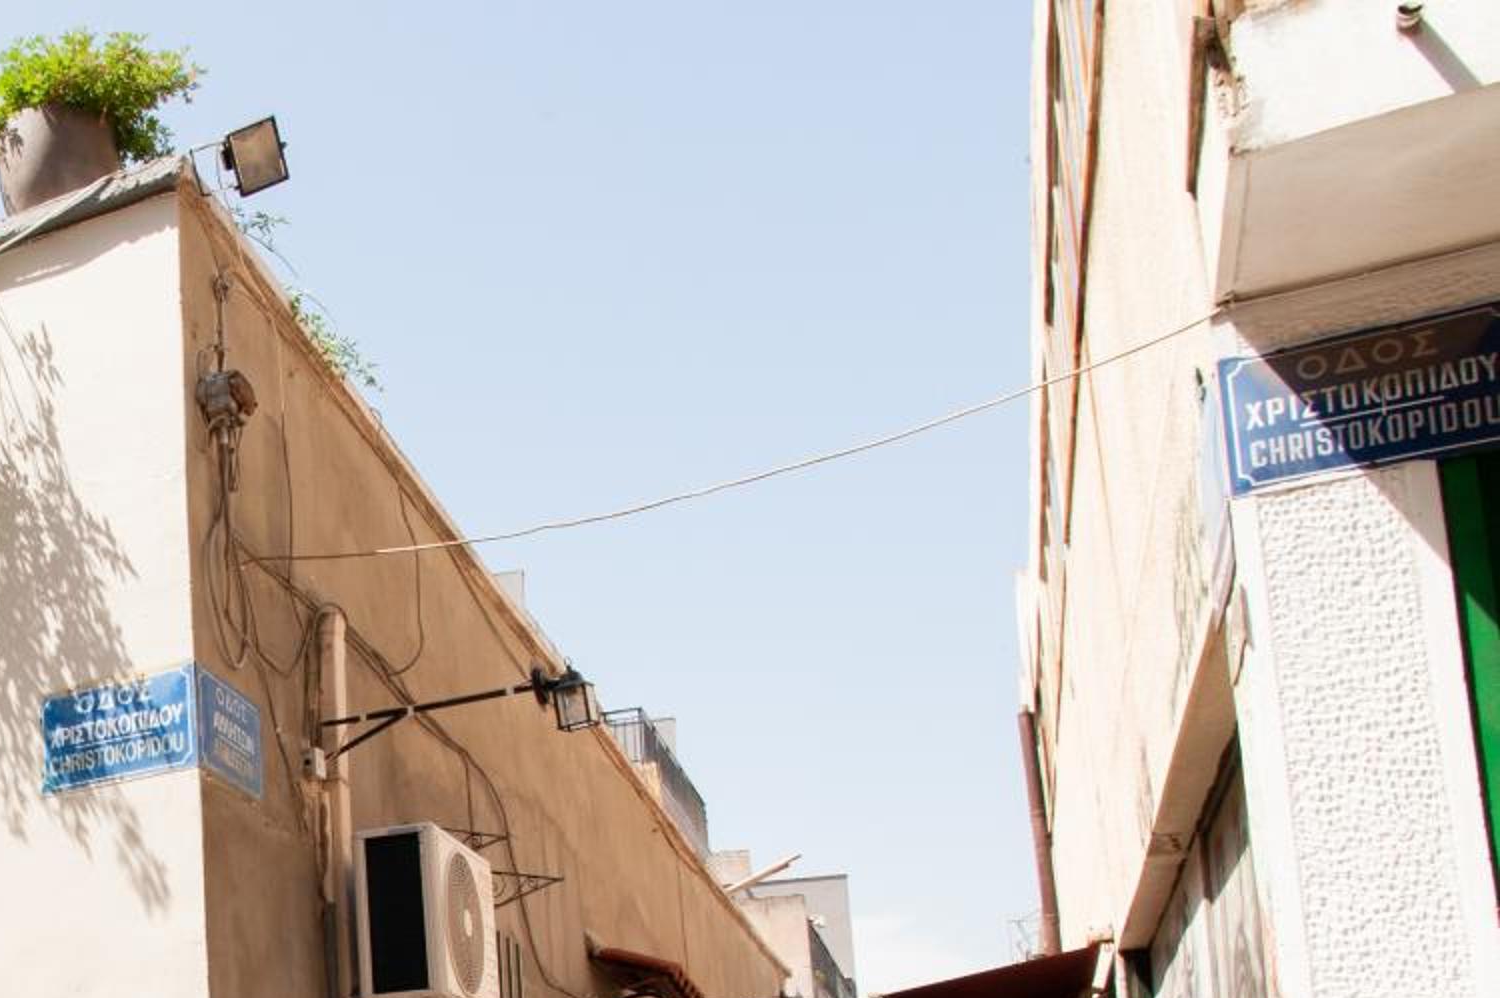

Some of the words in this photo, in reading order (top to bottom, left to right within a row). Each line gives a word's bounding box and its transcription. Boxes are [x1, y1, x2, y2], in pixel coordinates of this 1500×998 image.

[1296, 330, 1439, 380] ΟΔΟΣ
[1245, 352, 1500, 431] ΧΡΙΣΤΟΚΟΠΙΔΟΥ
[1249, 396, 1500, 468] CHRISTOKOPIDOU
[50, 703, 183, 749] ΧΡΙΣΤΟΚΟΠΙΔΟΥ
[50, 731, 184, 776] CHRISTOKOPIDOU
